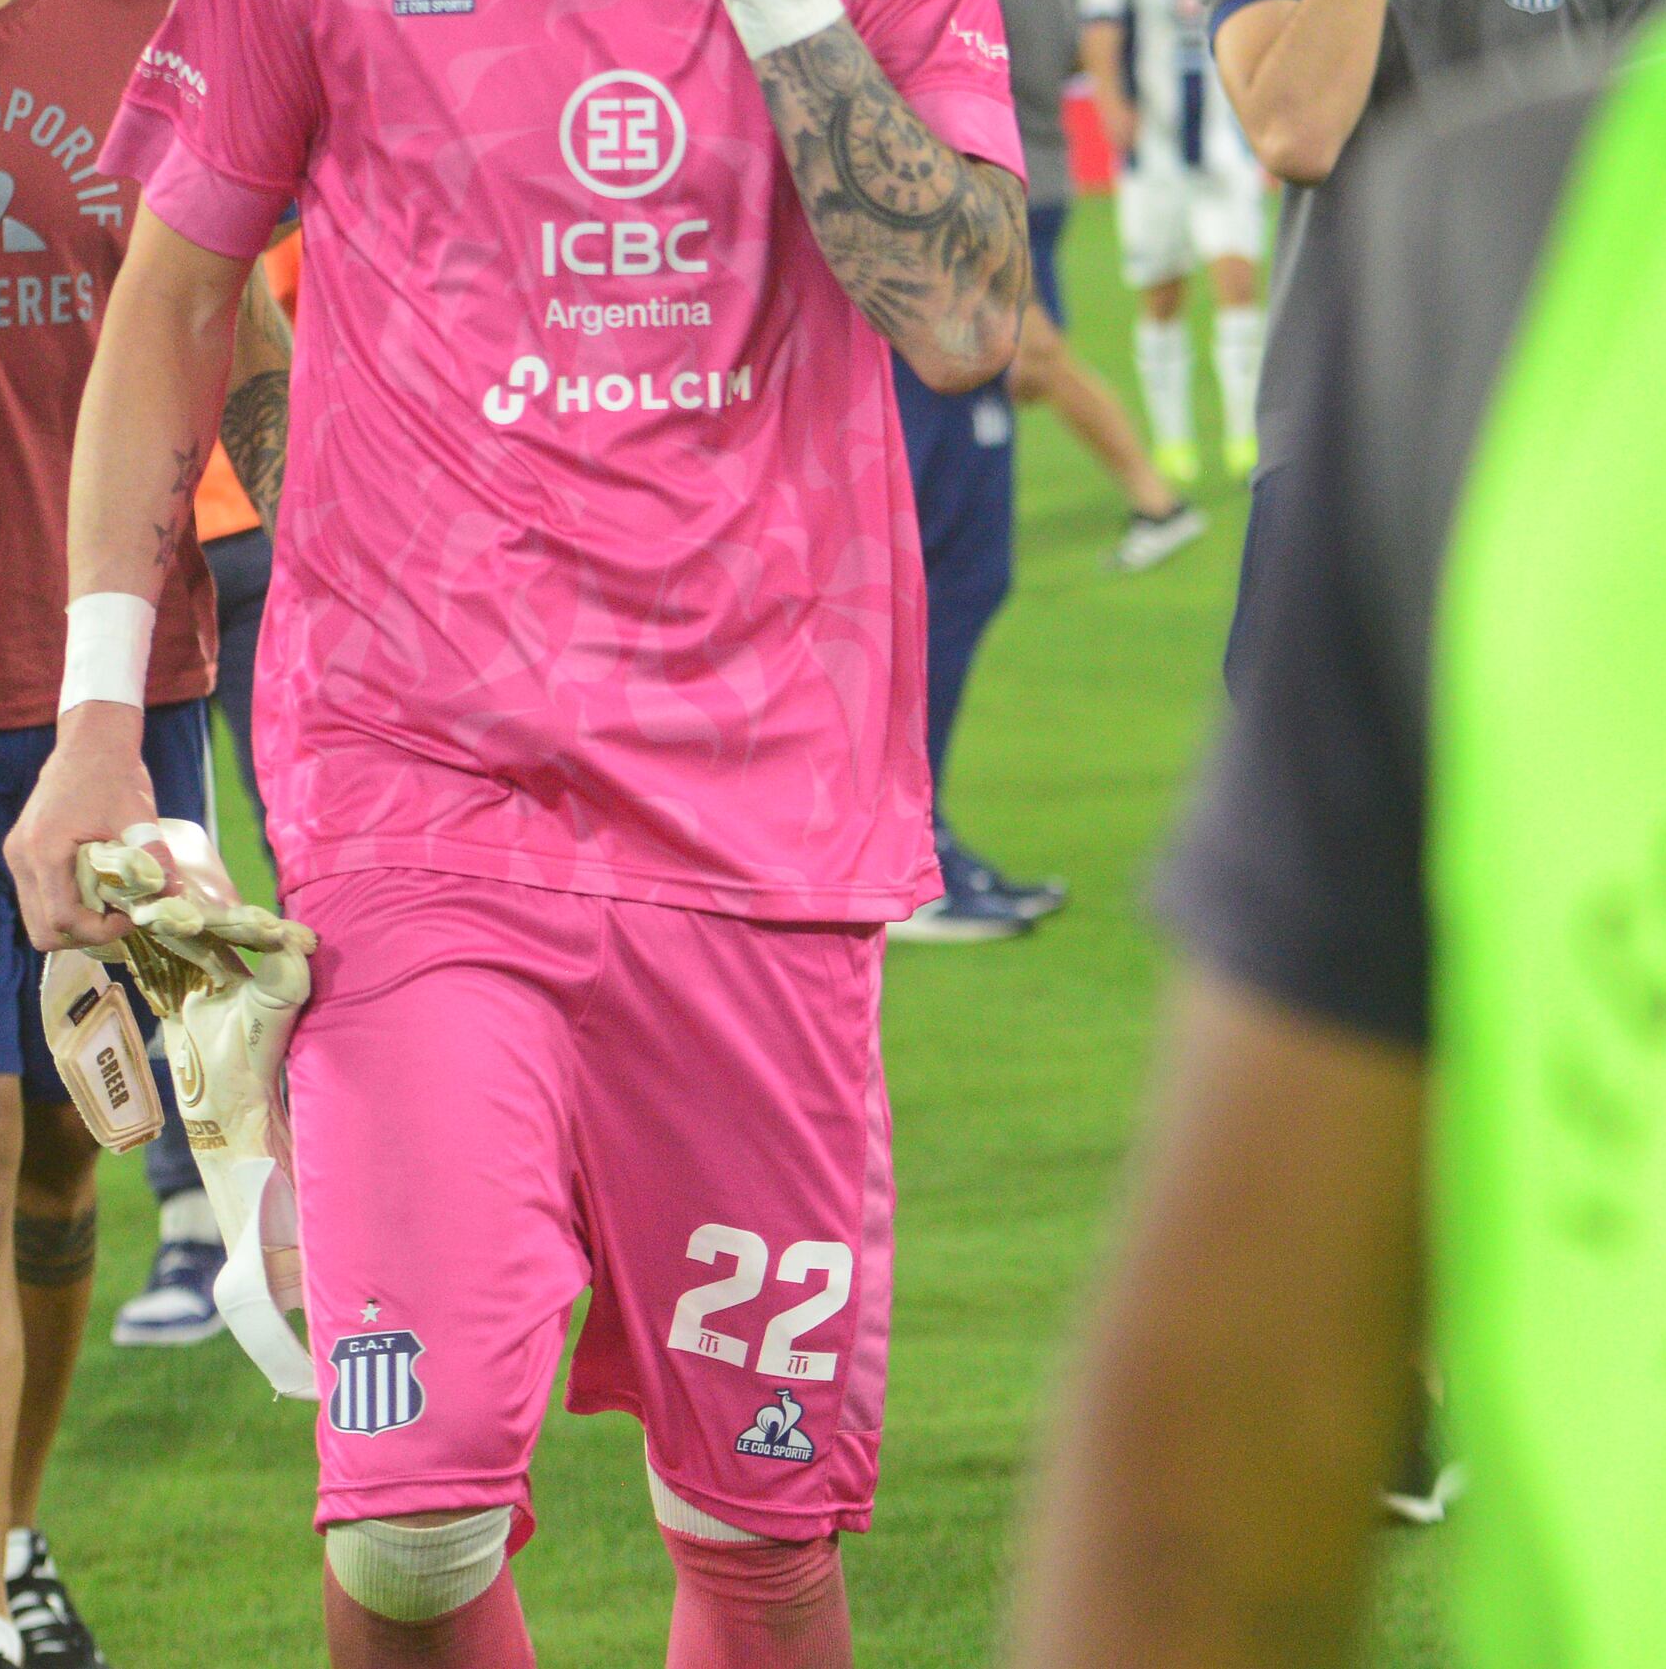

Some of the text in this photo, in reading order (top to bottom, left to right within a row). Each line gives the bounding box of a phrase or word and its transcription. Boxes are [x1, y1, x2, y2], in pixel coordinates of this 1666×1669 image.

[541, 219, 709, 277] ICBC
[543, 296, 712, 336] Argentina
[556, 364, 753, 414] HOLCIM
[96, 1046, 130, 1111] CREER
[667, 1223, 854, 1382] 22
[736, 1439, 813, 1461] LE COQ SPORTIF
